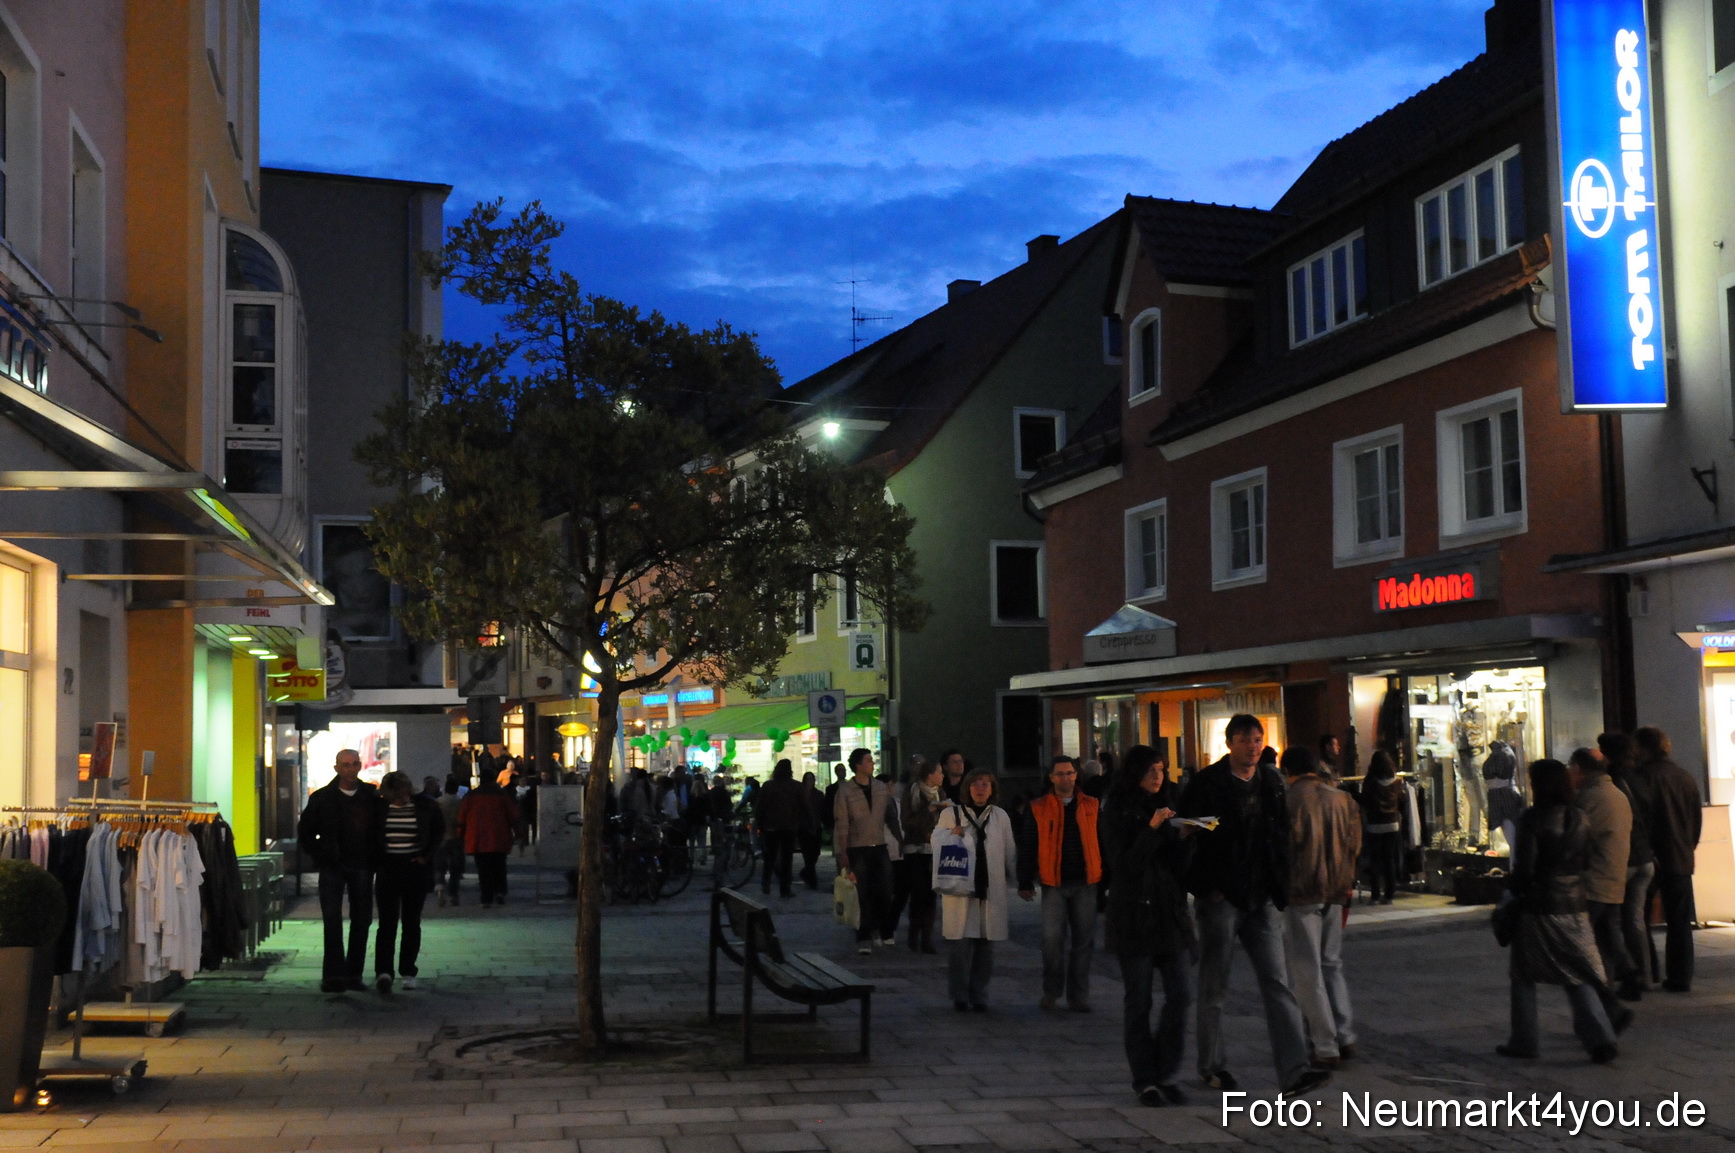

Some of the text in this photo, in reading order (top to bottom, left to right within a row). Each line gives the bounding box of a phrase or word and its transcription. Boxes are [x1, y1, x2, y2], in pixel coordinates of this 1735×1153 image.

[1614, 28, 1655, 372] TOM TAILOR
[1378, 571, 1475, 610] Madonna
[1100, 633, 1157, 652] Creppresso
[274, 676, 319, 687] LOTTO
[818, 716, 837, 724] ZONE
